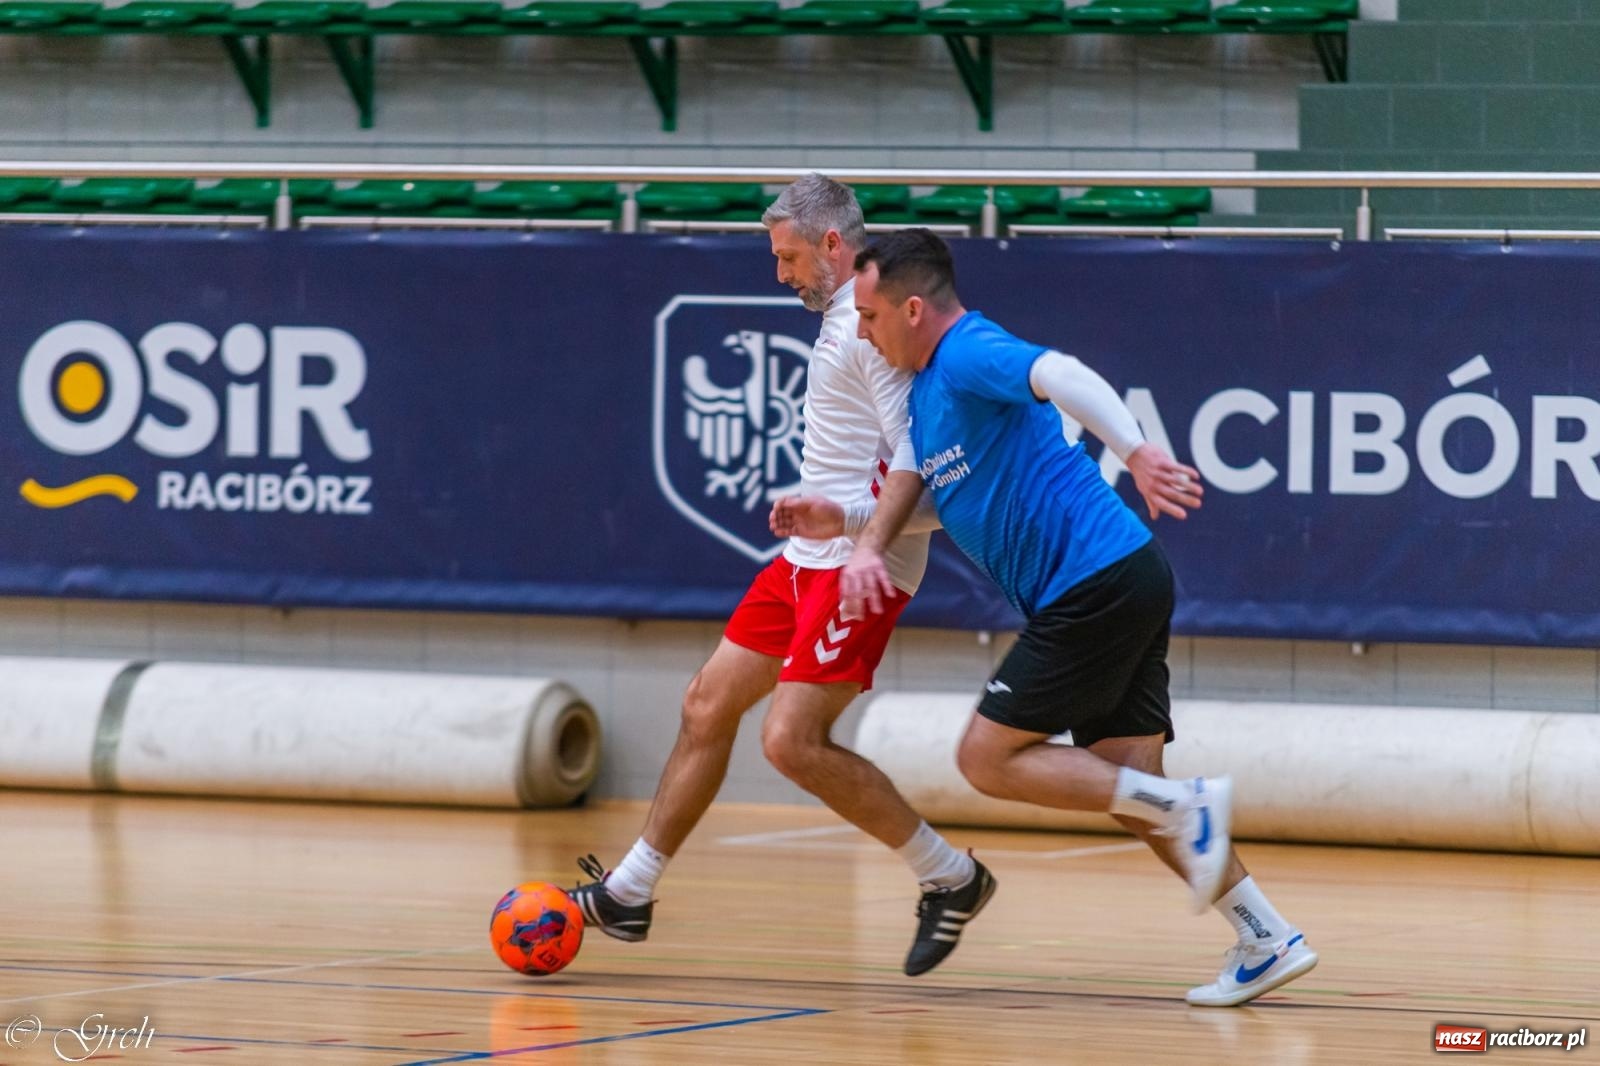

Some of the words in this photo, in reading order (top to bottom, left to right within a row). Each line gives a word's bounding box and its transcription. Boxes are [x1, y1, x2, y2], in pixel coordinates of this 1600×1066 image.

[18, 319, 372, 462] OSiR
[1060, 354, 1600, 501] ACIBÓR
[157, 463, 372, 514] RACIBÓRZ
[934, 461, 971, 488] GmbH
